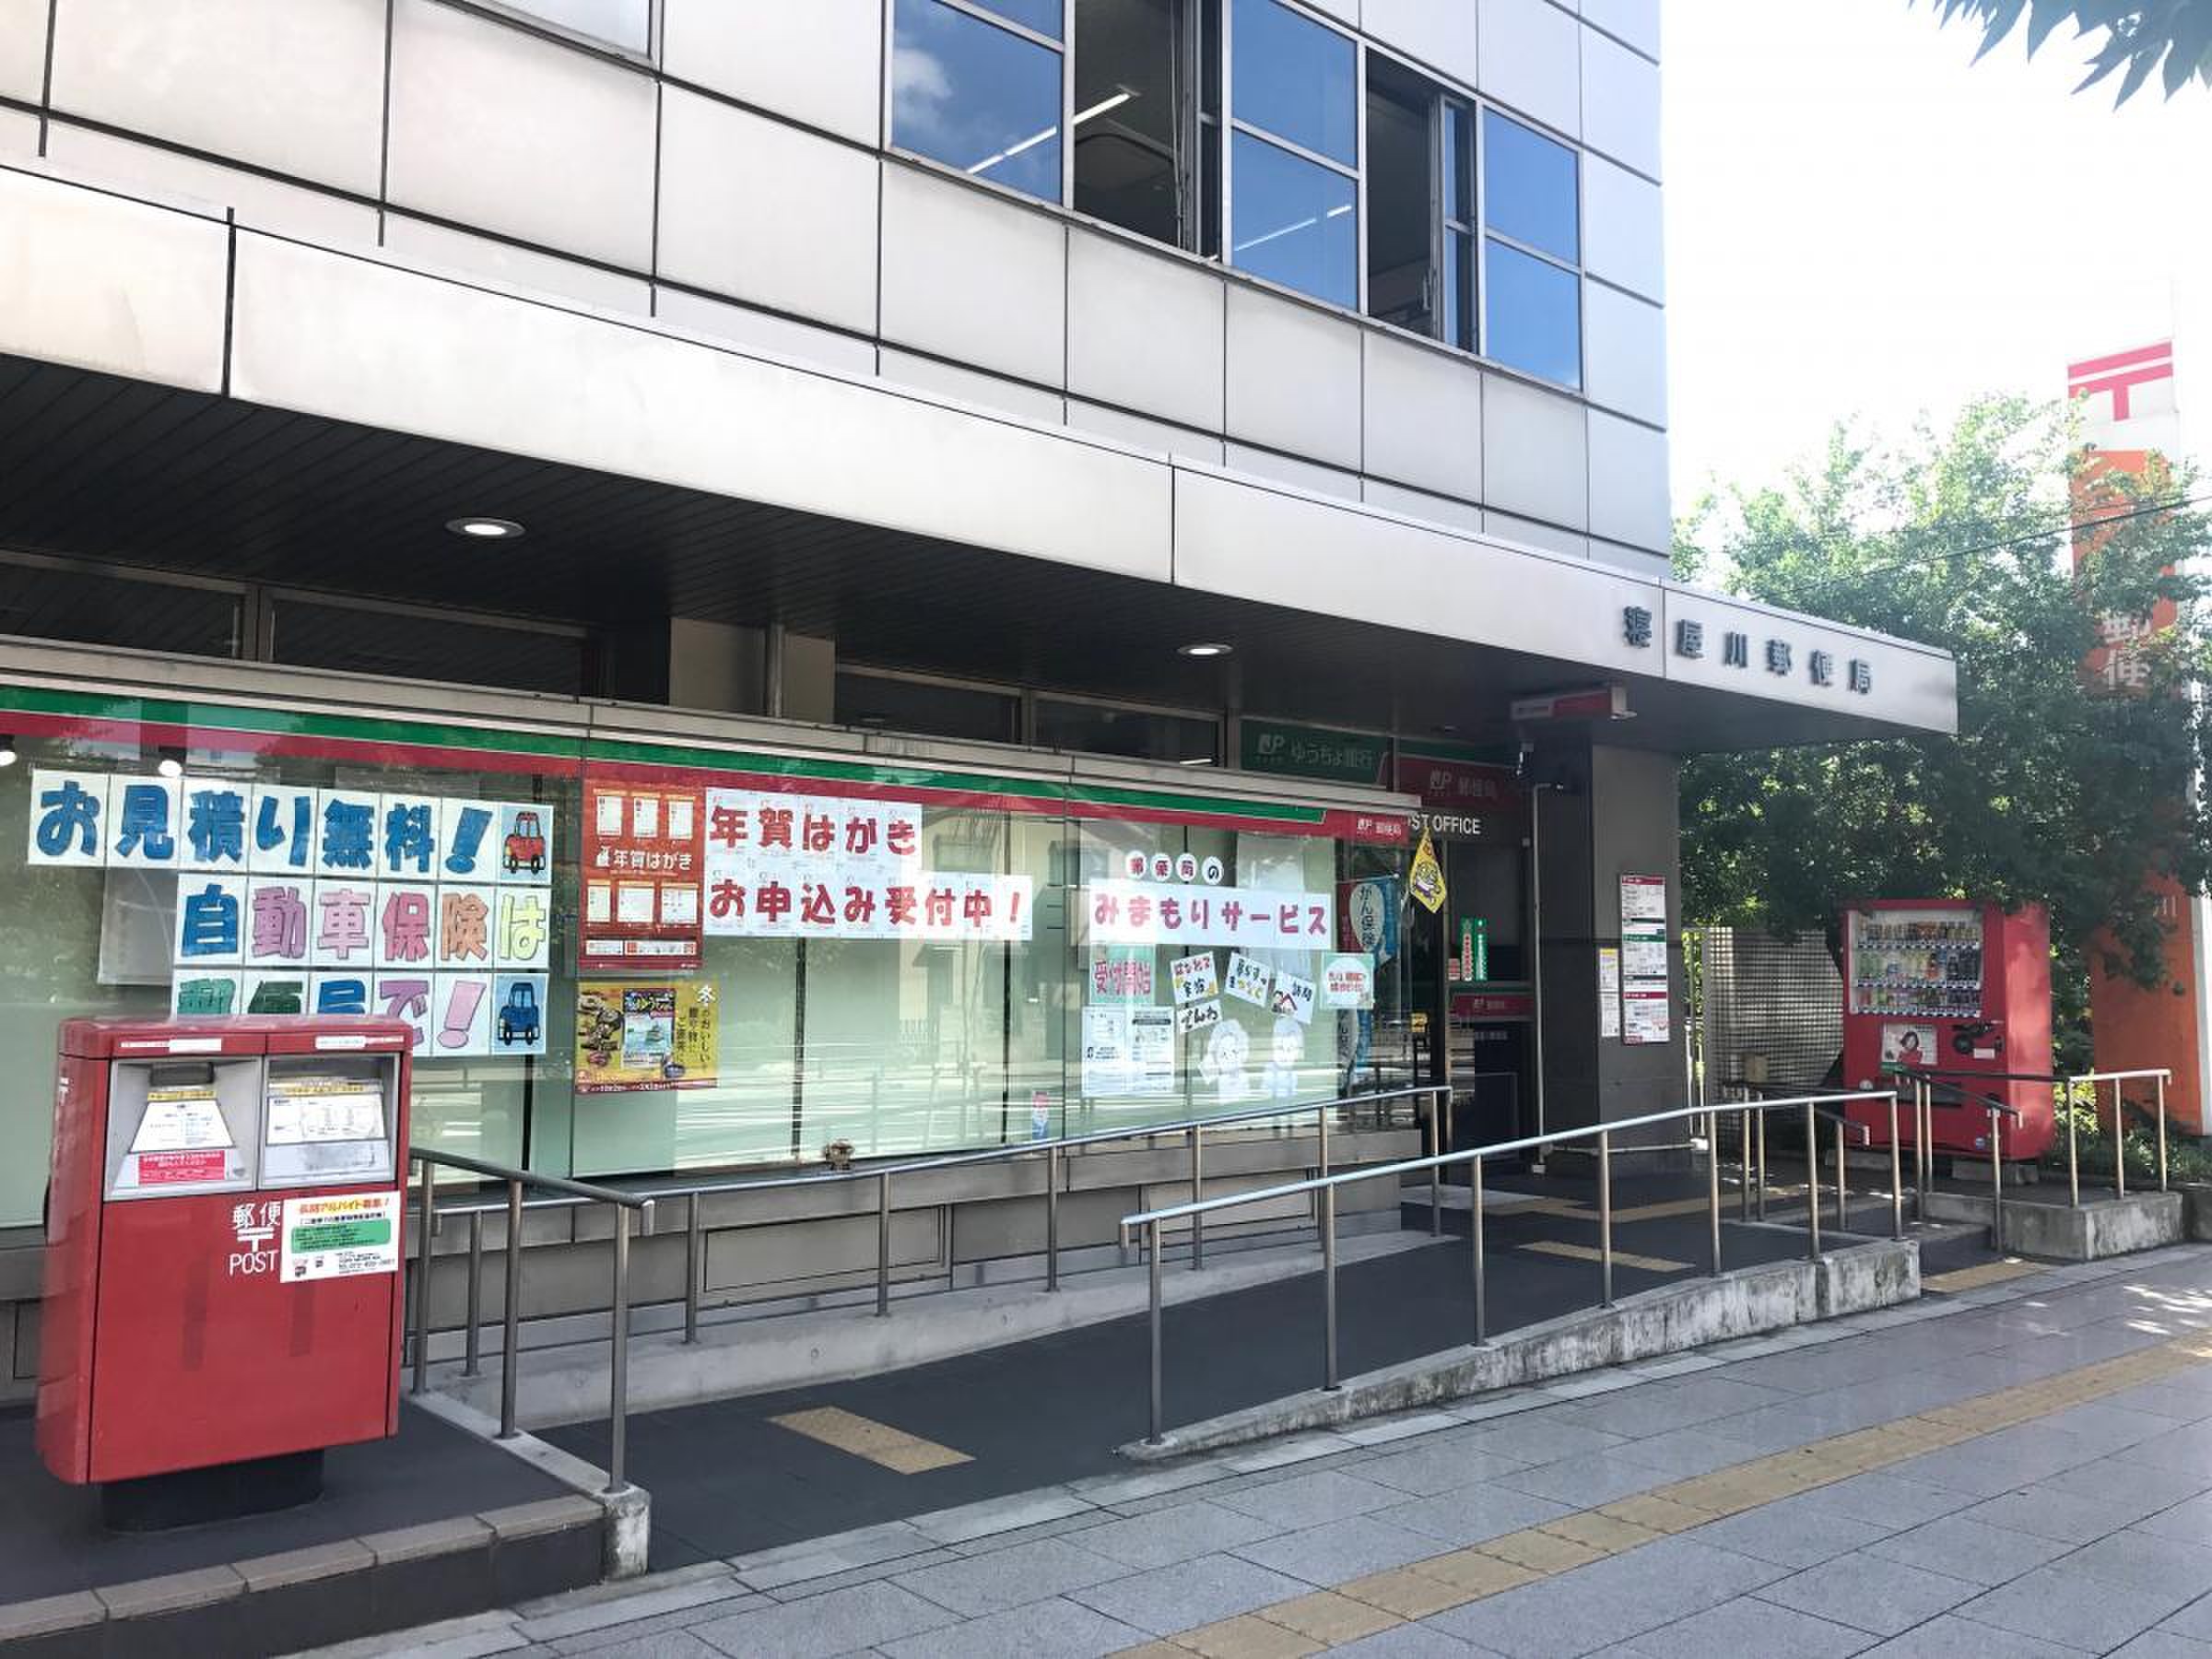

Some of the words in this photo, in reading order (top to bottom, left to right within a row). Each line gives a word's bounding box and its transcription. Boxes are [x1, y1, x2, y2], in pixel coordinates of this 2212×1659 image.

[36, 781, 493, 873] お見積り無料！
[709, 806, 917, 855] 年賀はがき
[1433, 815, 1481, 835] OFFICE
[185, 884, 547, 962] 自動車保険は
[709, 880, 1020, 927] お申込み受付中！
[1094, 895, 1327, 935] みまもりサービス
[231, 1201, 280, 1230] 郵便
[229, 1250, 278, 1276] POST
